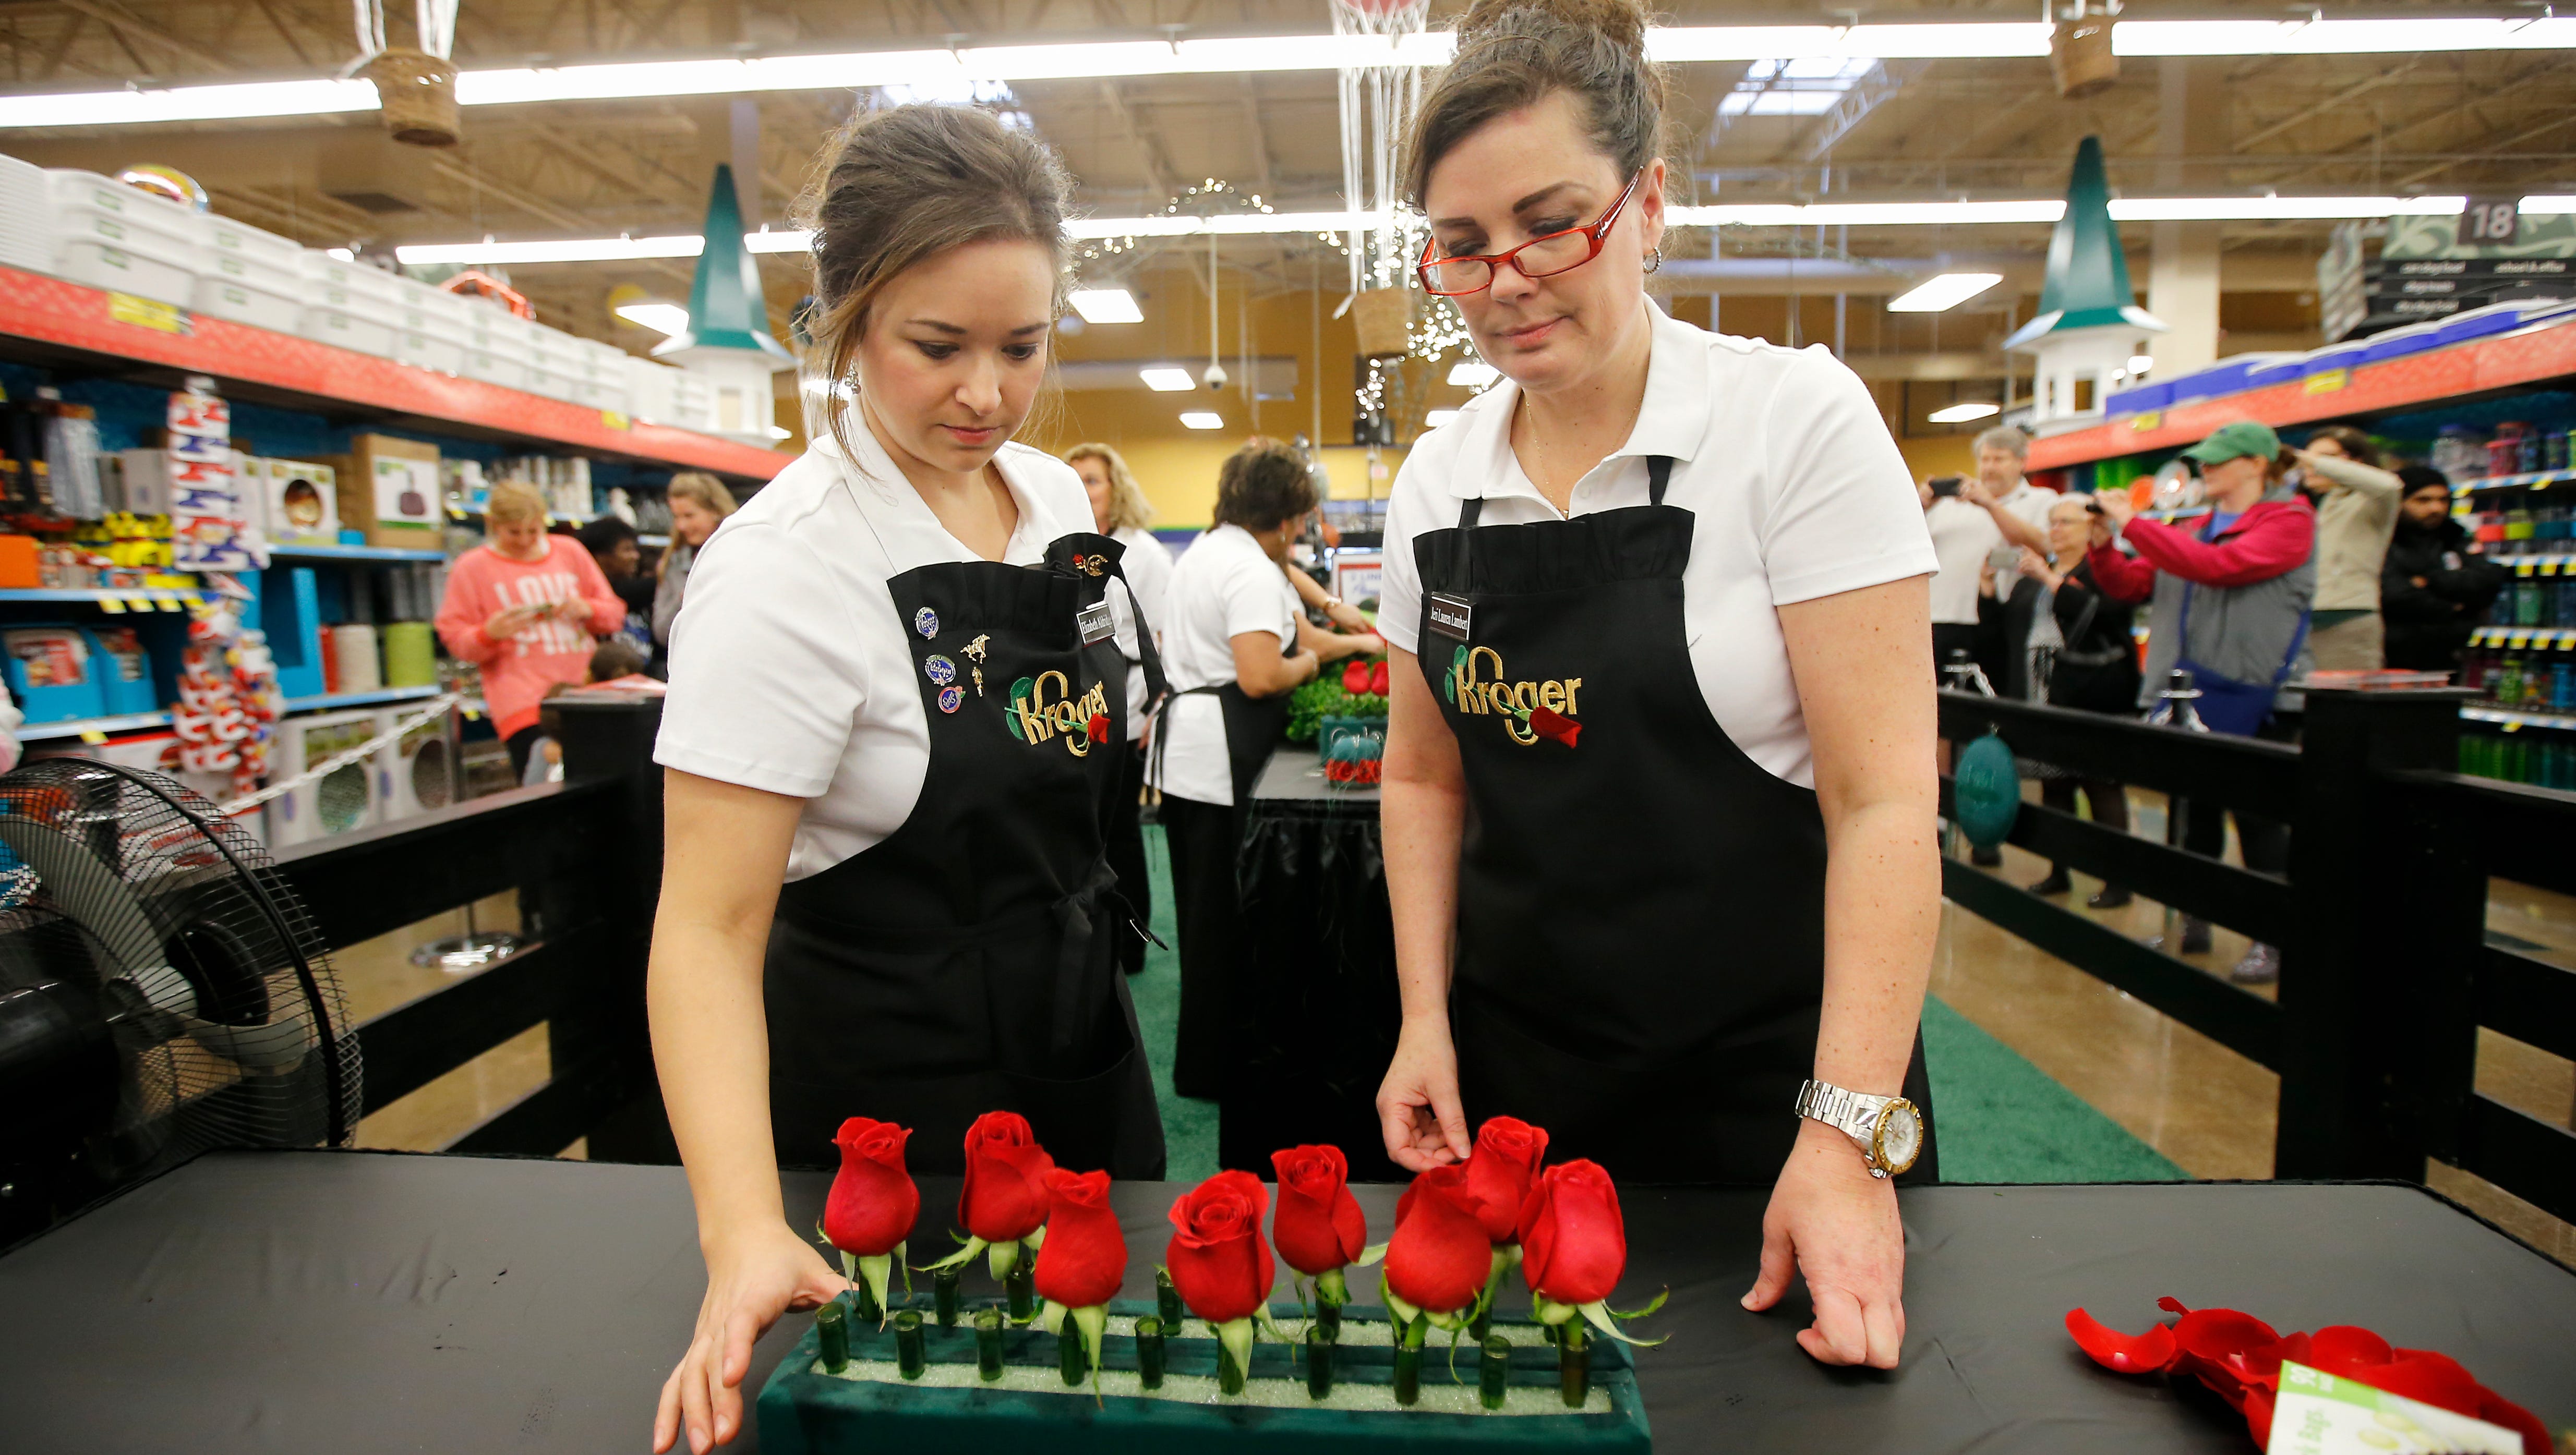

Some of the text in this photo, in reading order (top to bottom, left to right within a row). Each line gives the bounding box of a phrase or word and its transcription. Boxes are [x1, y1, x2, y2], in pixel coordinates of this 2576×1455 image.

[2471, 203, 2514, 238] 18
[1451, 612, 1467, 630] Lambert
[1017, 670, 1109, 757] Kroger
[1456, 646, 1582, 746] Kroger
